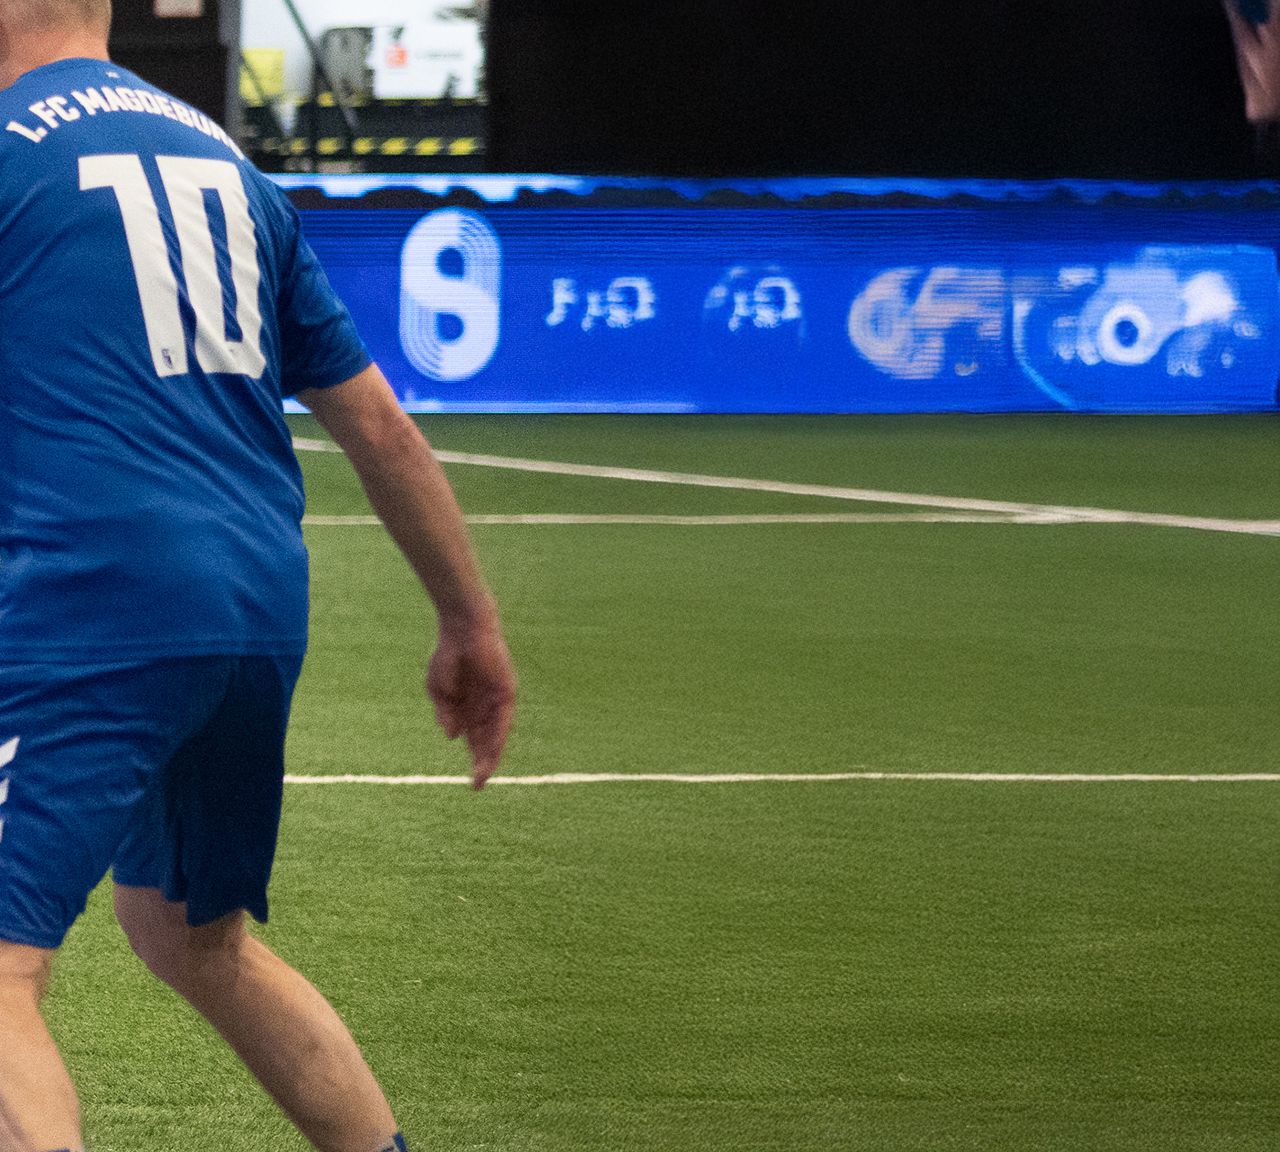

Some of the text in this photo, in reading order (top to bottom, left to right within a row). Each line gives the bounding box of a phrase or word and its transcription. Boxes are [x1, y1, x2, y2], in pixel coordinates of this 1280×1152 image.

[28, 95, 81, 129] FC
[70, 85, 245, 161] MAGDEBUR
[77, 153, 268, 380] 10
